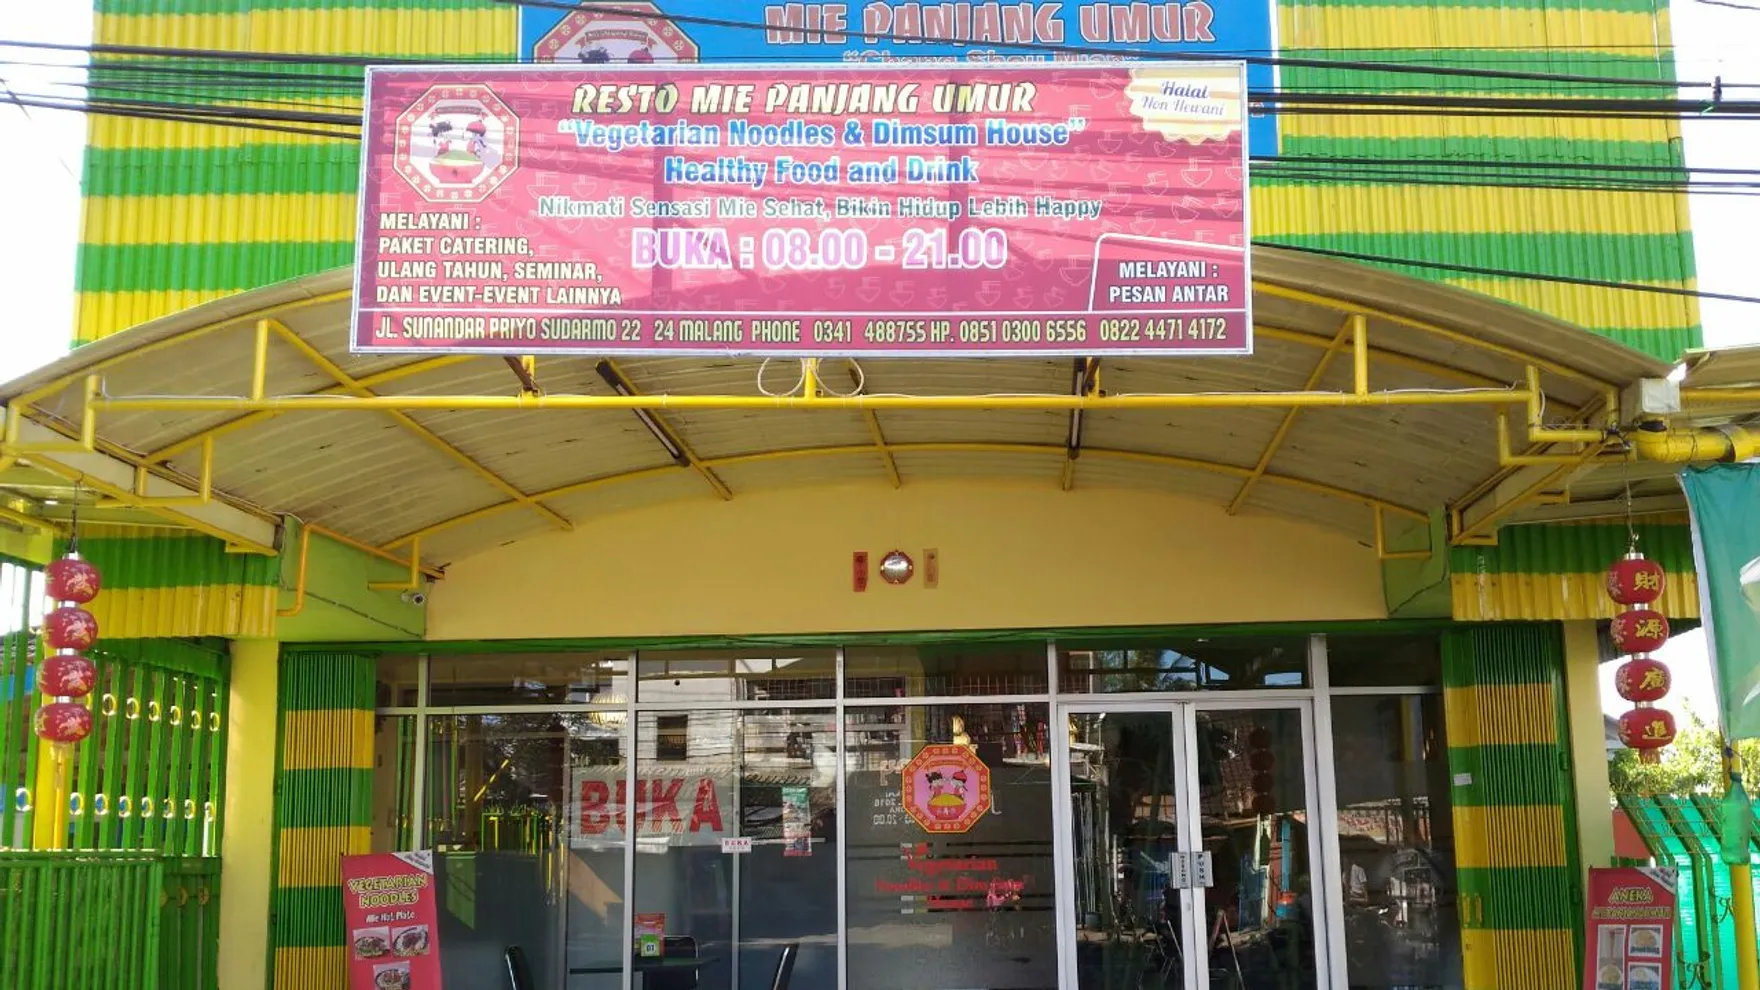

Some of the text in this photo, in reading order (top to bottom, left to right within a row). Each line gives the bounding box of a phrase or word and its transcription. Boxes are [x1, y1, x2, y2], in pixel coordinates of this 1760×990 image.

[765, 1, 1215, 46] MIE PANJANG UMUR
[572, 82, 1037, 114] RESTO MIE PANJANG UMUR
[1162, 80, 1208, 99] Halal
[730, 120, 834, 146] Noodles
[843, 120, 865, 146] &
[873, 120, 978, 146] Dimsum
[664, 156, 979, 188] Healthy Food and Drink
[539, 197, 1102, 221] Nikmati Sensasi Mie Sehat, Bikin Hidup Lebih Happy
[380, 213, 469, 230] MELAYANI
[379, 237, 534, 258] PAKET CATERING,
[630, 227, 732, 270] BUKA
[761, 227, 868, 270] 08.00
[902, 227, 1008, 269] 21.00
[377, 261, 604, 283] ULANG TAHUN, SEMINAR,
[1119, 261, 1207, 279] MELAYANI
[376, 286, 622, 306] DAN EVENT-EVENT LAINNYA
[1109, 286, 1229, 304] PESAN ANTAR
[375, 316, 1227, 343] JL. SUNANDAR PRIYO SUDARMO 22 24 MALANG PHONE 0341 488755 HP. 0851 0300 6556 0822 4471 4172
[580, 778, 723, 835] BUKA
[347, 873, 428, 895] VEGETARIAN
[359, 888, 419, 908] NOODLES
[1608, 886, 1654, 905] ANEKA
